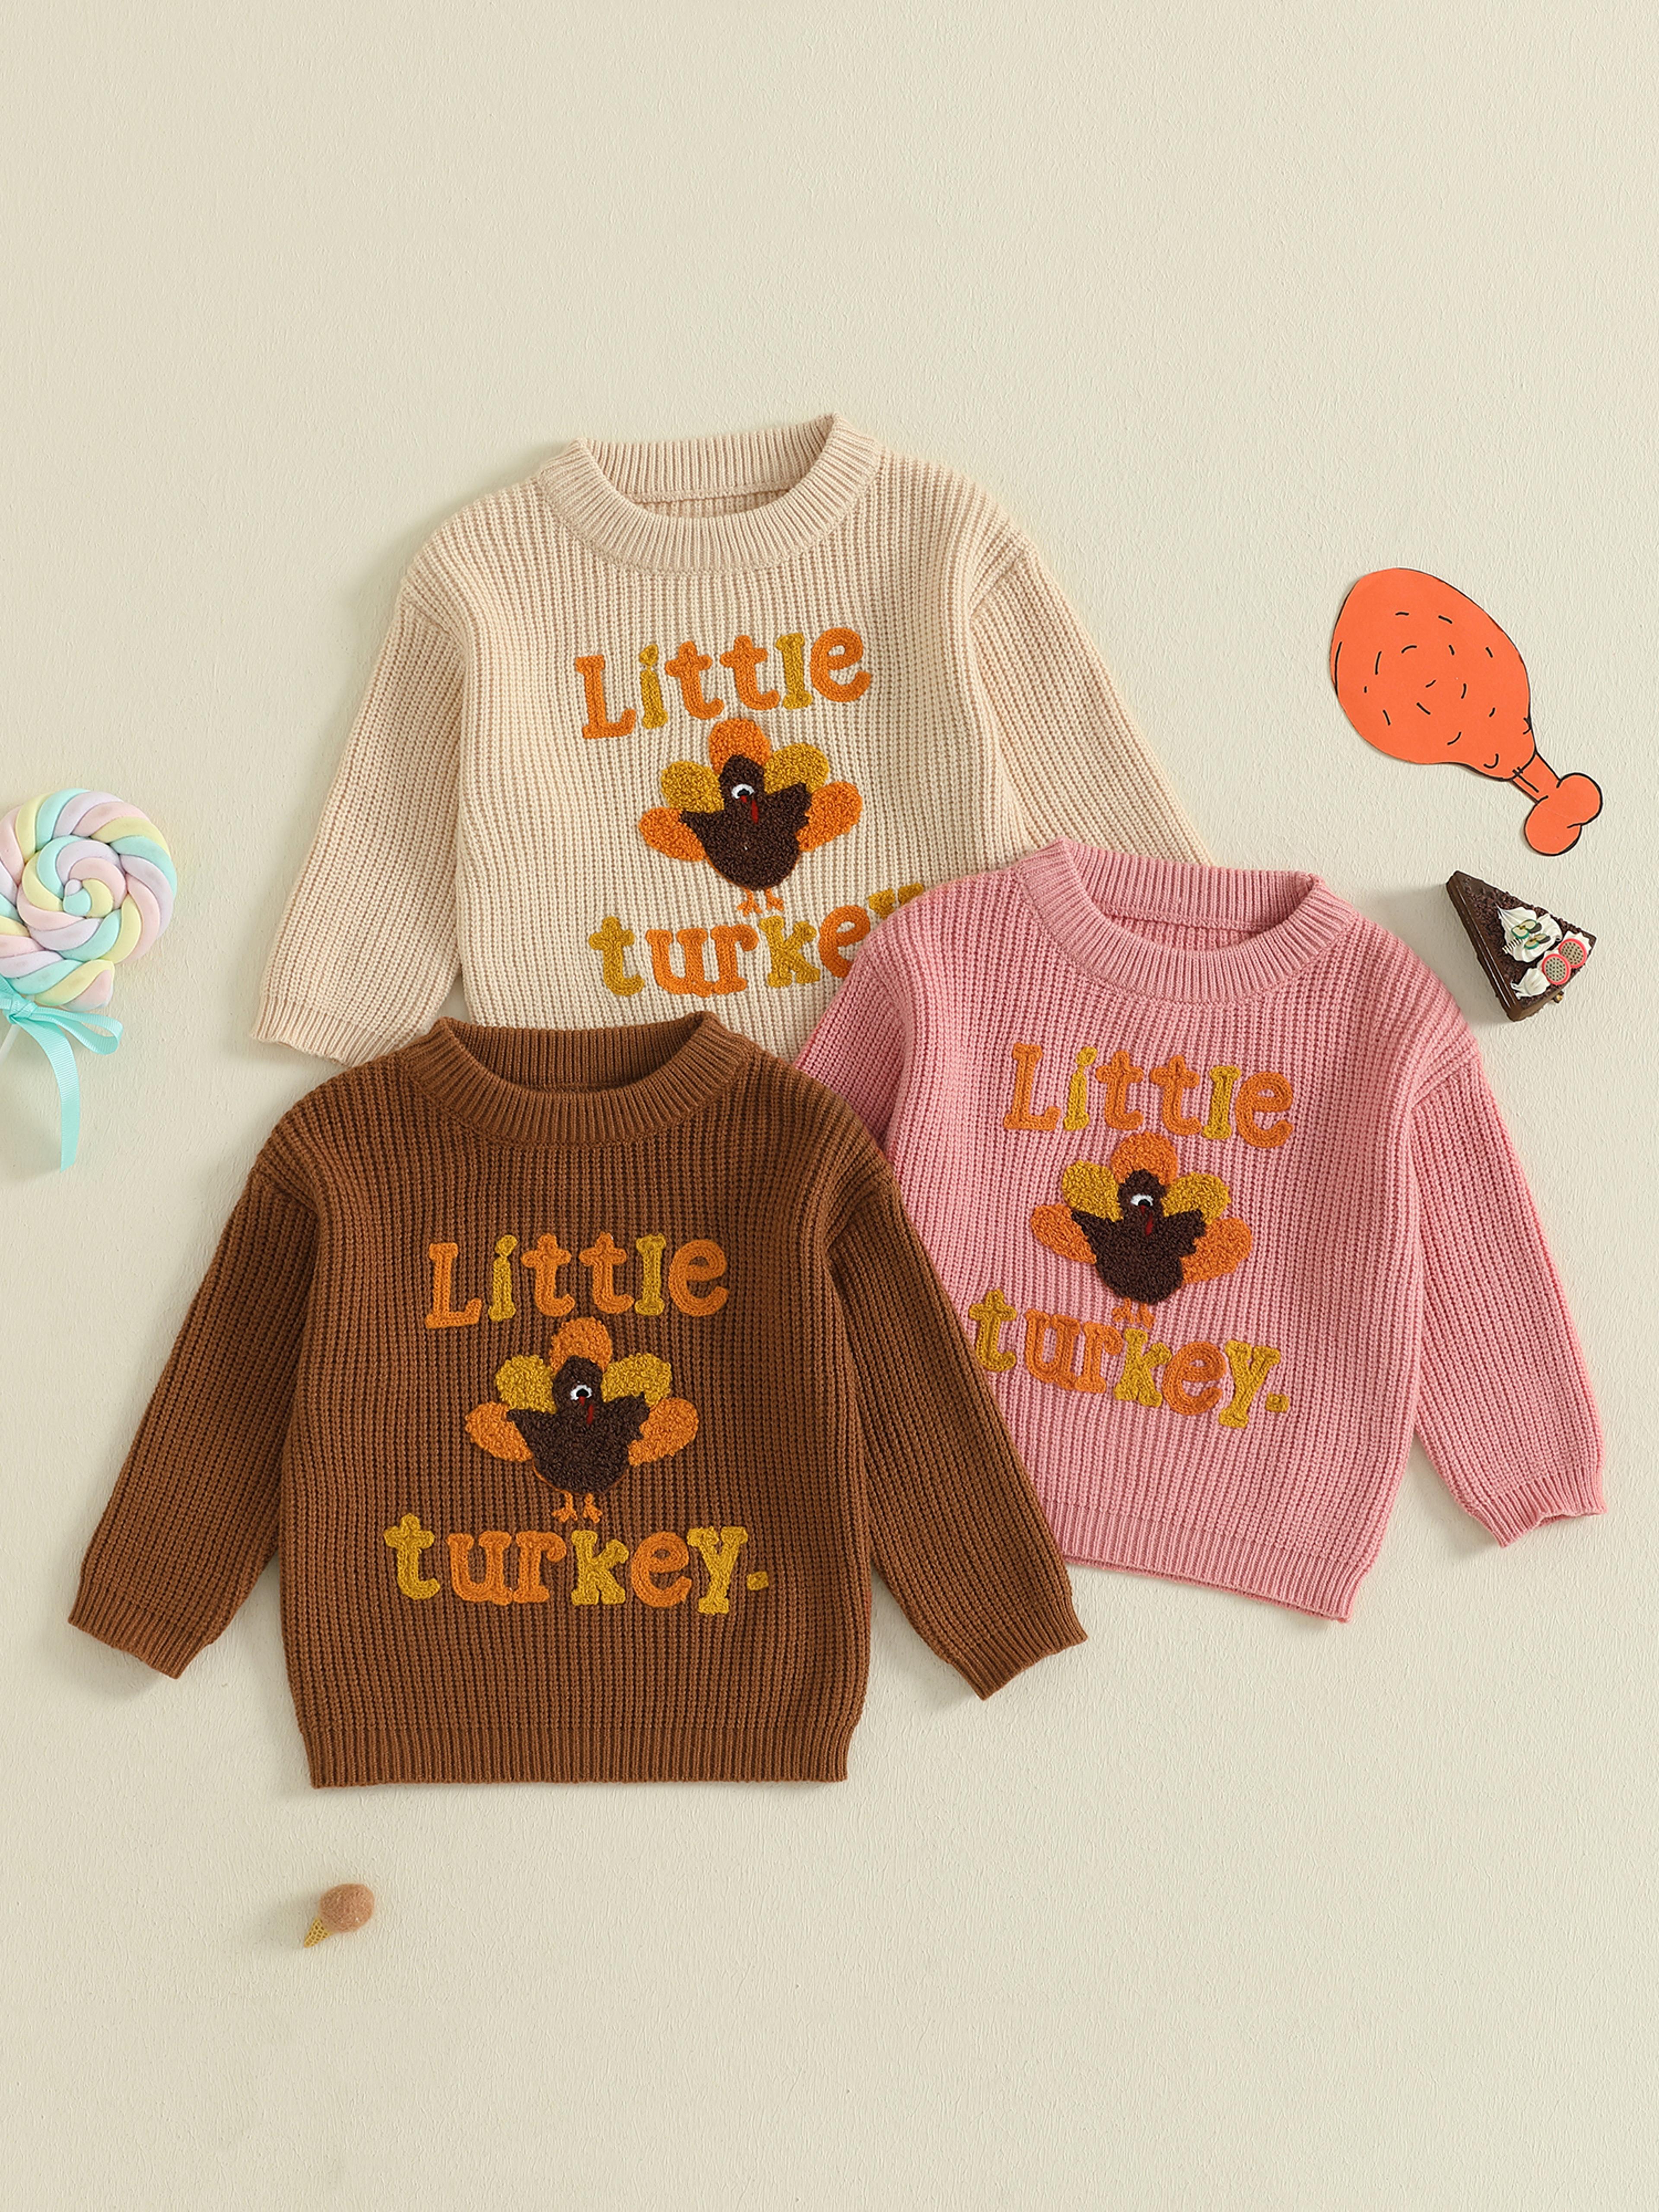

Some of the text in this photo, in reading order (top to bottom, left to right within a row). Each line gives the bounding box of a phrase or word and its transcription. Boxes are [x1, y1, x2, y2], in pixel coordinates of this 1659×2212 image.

[575, 627, 871, 739] Little
[1003, 1042, 1294, 1148] Little
[426, 1233, 728, 1329] Little
[969, 1289, 1290, 1428] turkey.
[383, 1513, 769, 1614] turkey.
